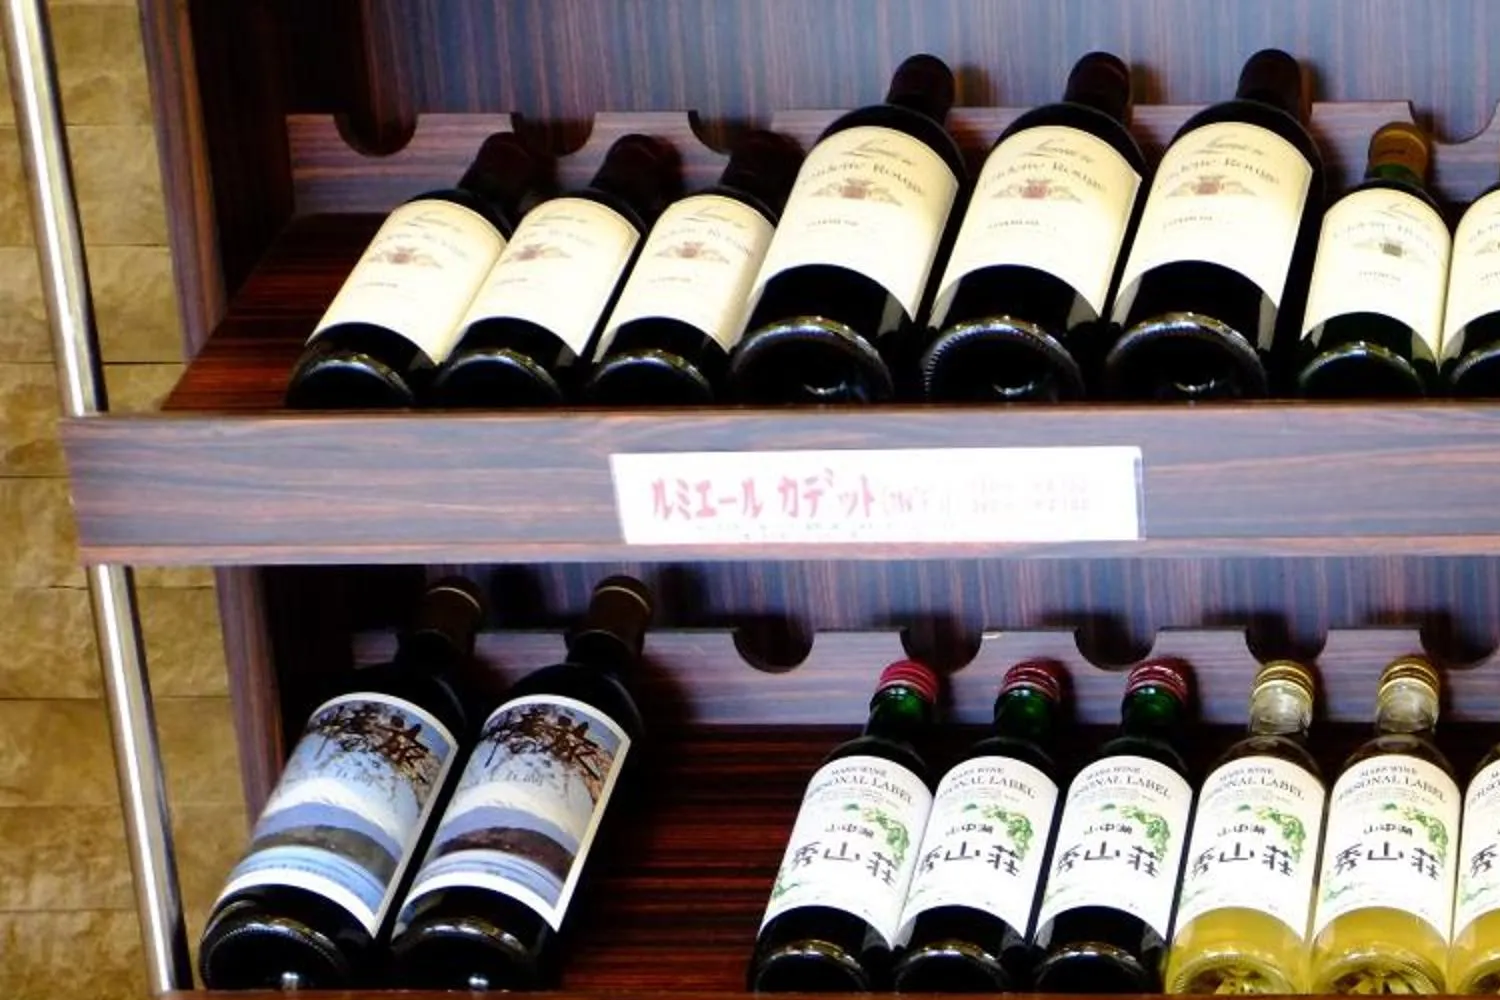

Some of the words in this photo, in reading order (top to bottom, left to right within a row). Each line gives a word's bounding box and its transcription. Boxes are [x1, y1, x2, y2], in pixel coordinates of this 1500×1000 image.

[651, 476, 763, 520] ルミエール
[777, 467, 877, 519] カデット
[871, 777, 913, 805] LABEL
[989, 776, 1037, 801] LABEL
[1127, 775, 1172, 800] LABEL
[1261, 775, 1306, 802] LABEL
[1405, 774, 1448, 803] LABEL
[791, 840, 900, 887] 秀山荘
[919, 840, 1021, 878] 秀山荘
[1056, 840, 1161, 879] 秀山荘
[1191, 841, 1295, 882] 秀山荘
[1334, 840, 1440, 881] 秀山荘
